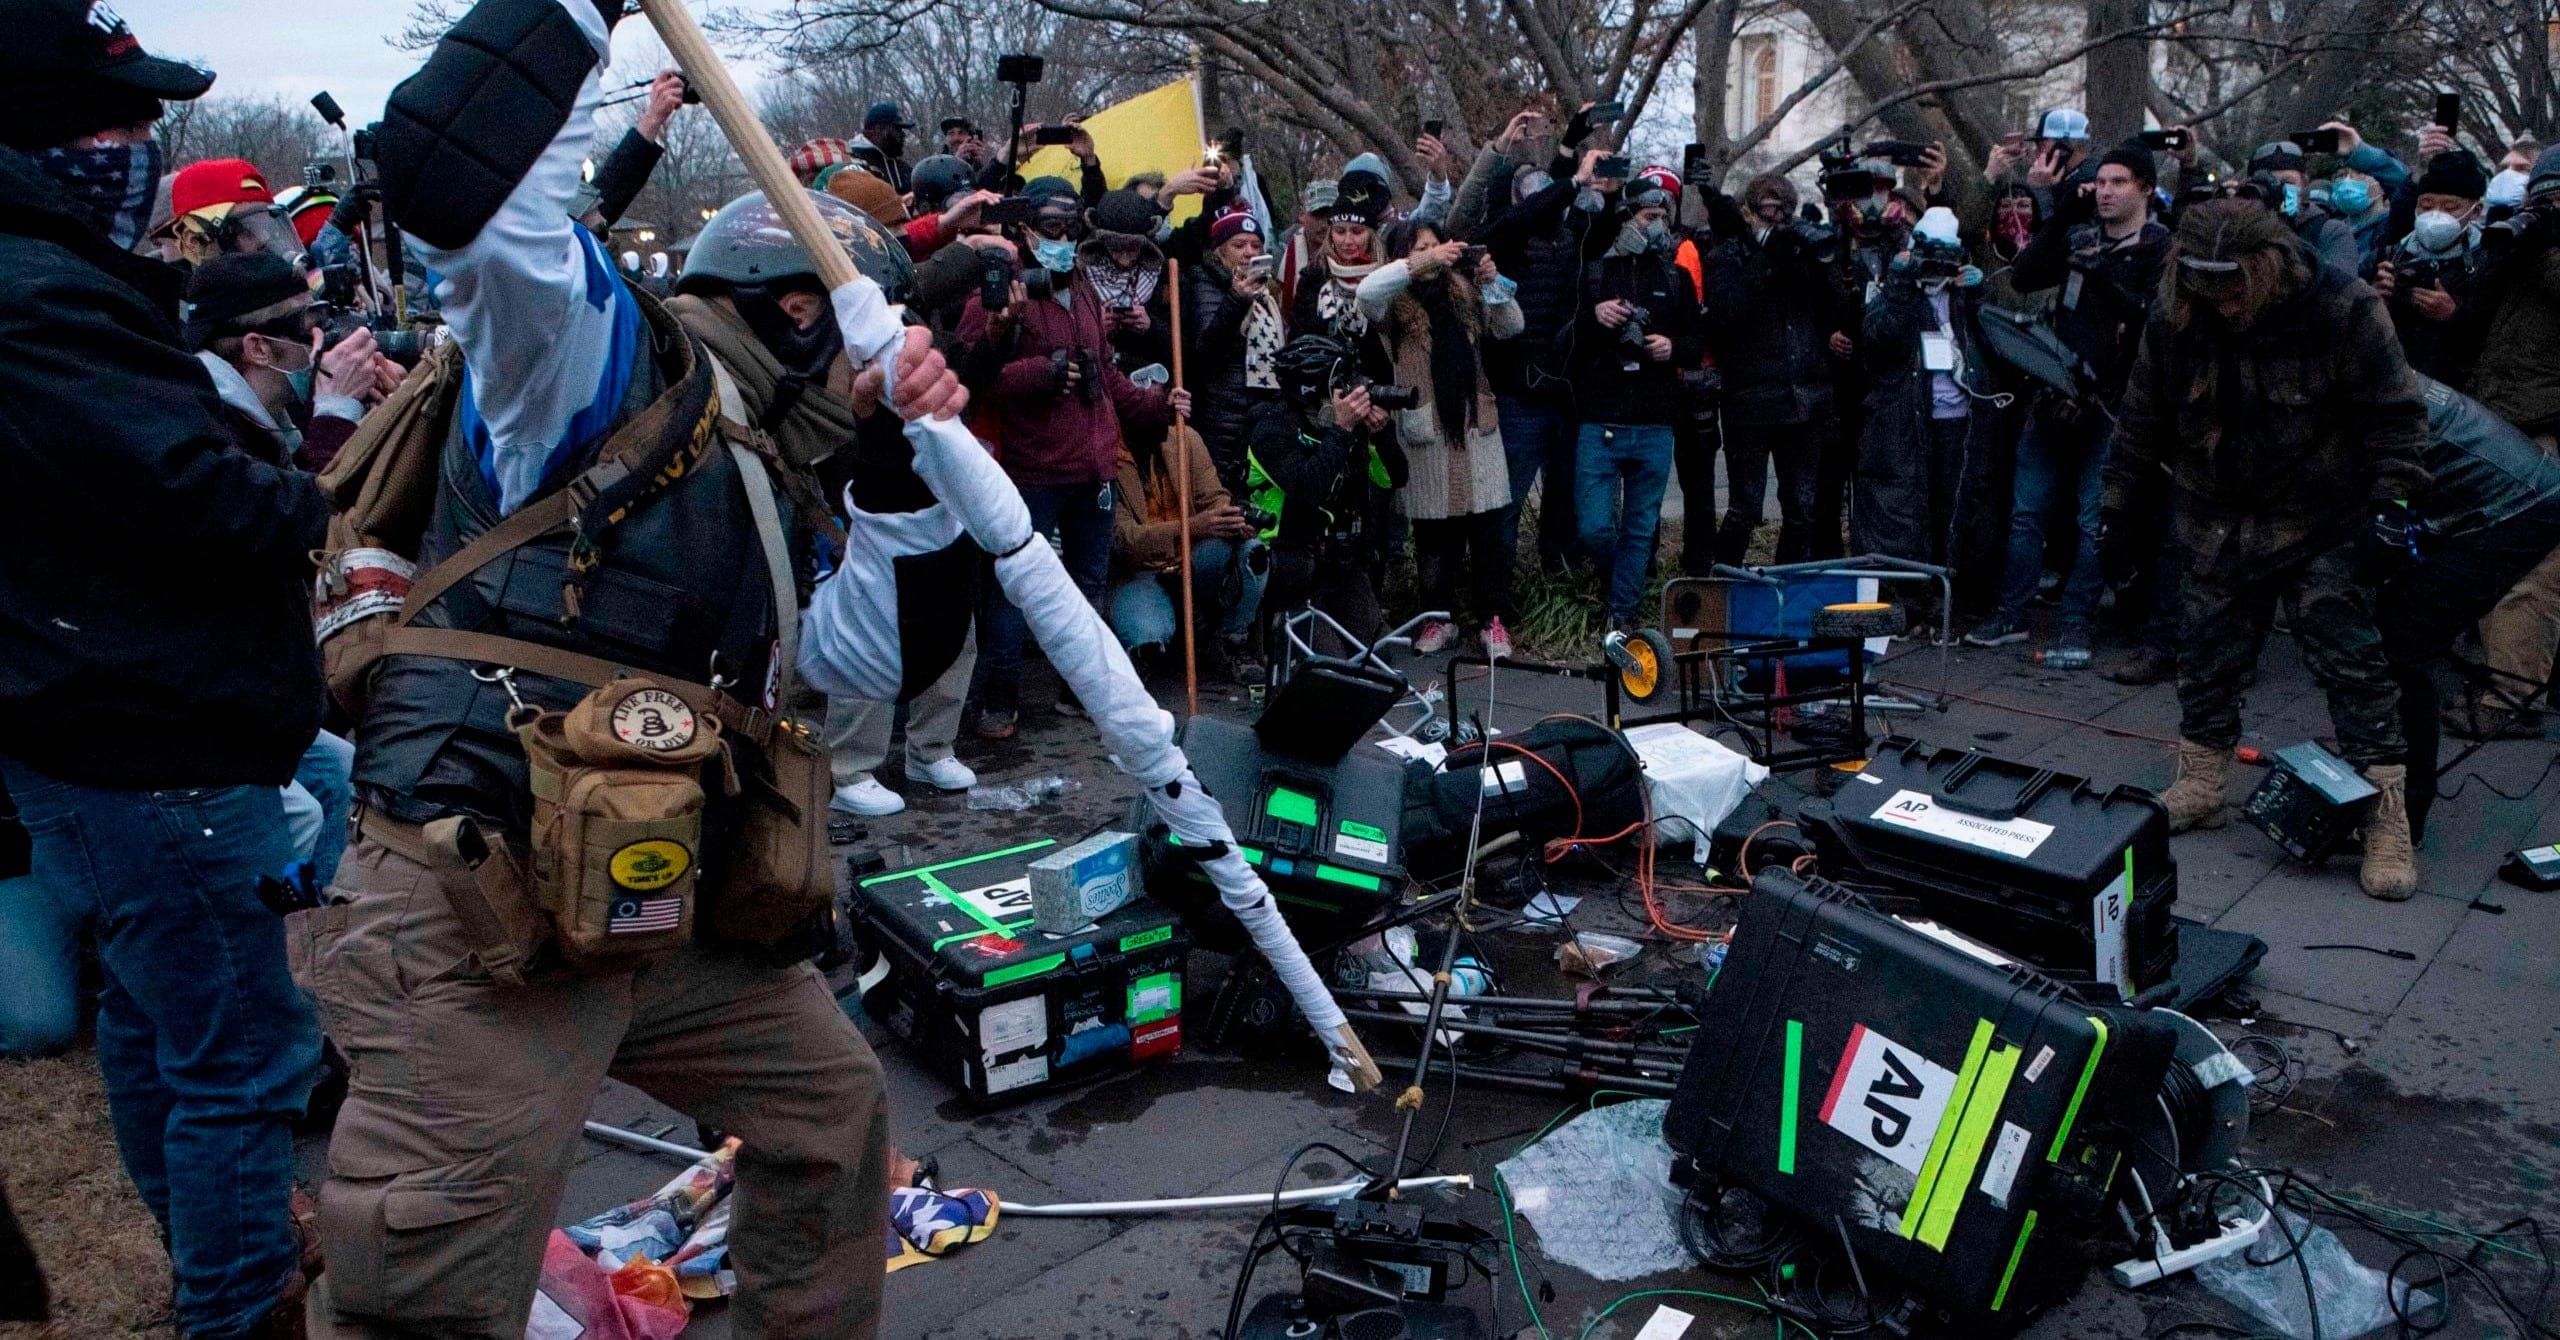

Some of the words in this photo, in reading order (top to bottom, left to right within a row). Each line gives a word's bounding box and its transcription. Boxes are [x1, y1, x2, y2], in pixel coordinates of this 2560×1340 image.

[615, 696, 641, 721] LIVE
[645, 692, 686, 713] FREE
[636, 738, 657, 748] OR
[662, 732, 688, 748] DIE
[1894, 800, 1929, 813] AP
[1957, 818, 2009, 838] ASSOCIATED
[2008, 830, 2037, 844] PRESS
[983, 888, 1033, 908] AP
[1087, 873, 1126, 905] Scotties
[2108, 892, 2119, 921] AP
[1863, 1047, 1925, 1148] AP
